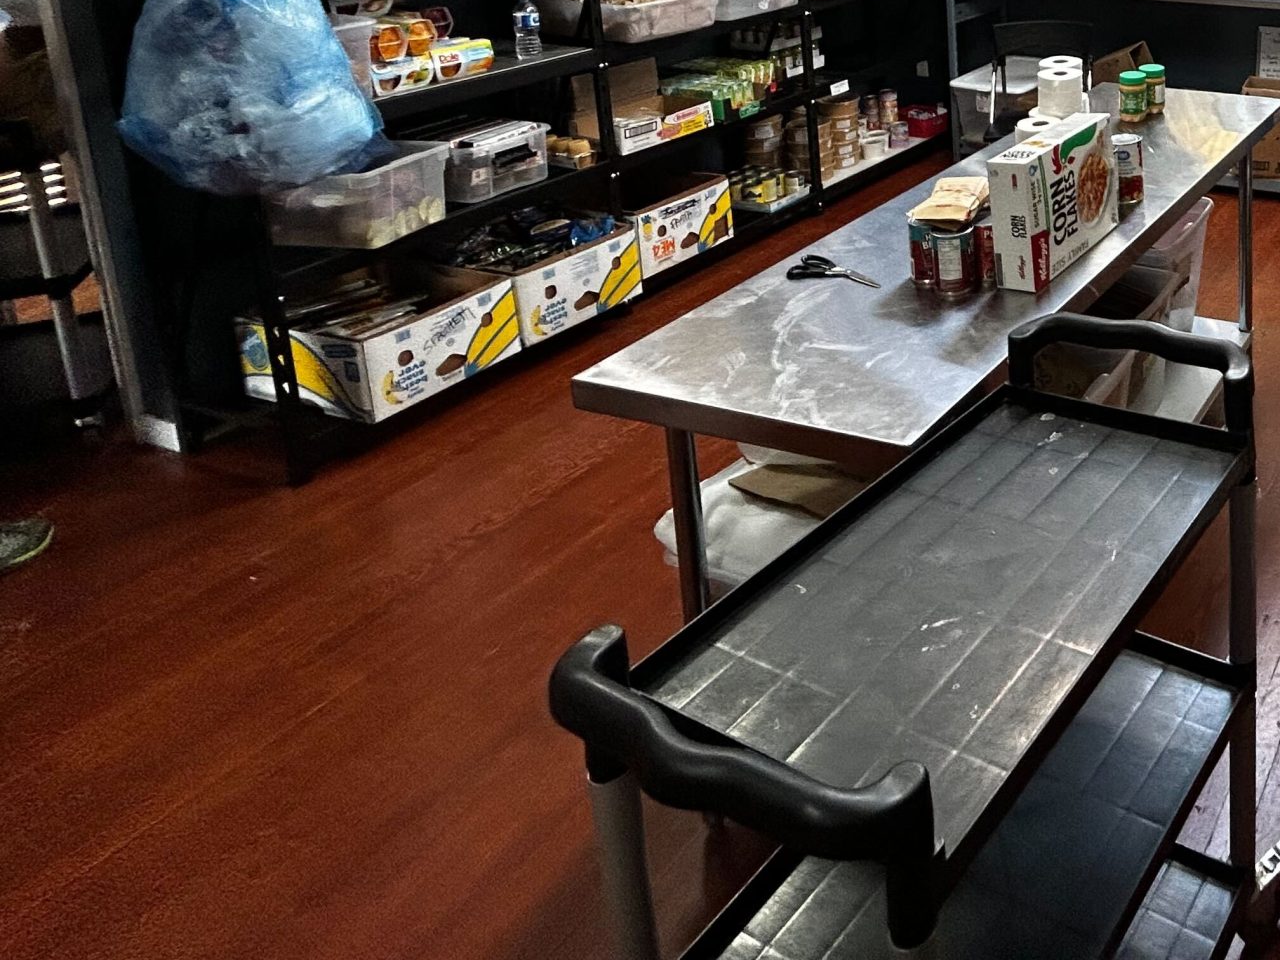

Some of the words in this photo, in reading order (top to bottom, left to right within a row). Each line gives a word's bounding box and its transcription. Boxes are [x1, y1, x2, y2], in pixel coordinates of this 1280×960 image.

[439, 52, 459, 64] Dole
[1050, 176, 1068, 246] CORN
[1063, 169, 1079, 239] FLAKES
[1010, 214, 1020, 239] CORN
[1037, 238, 1050, 281] Kellogg's
[1068, 238, 1090, 265] FAMILY
[1051, 256, 1067, 276] SIZE
[545, 298, 567, 312] ever
[398, 360, 427, 378] ever
